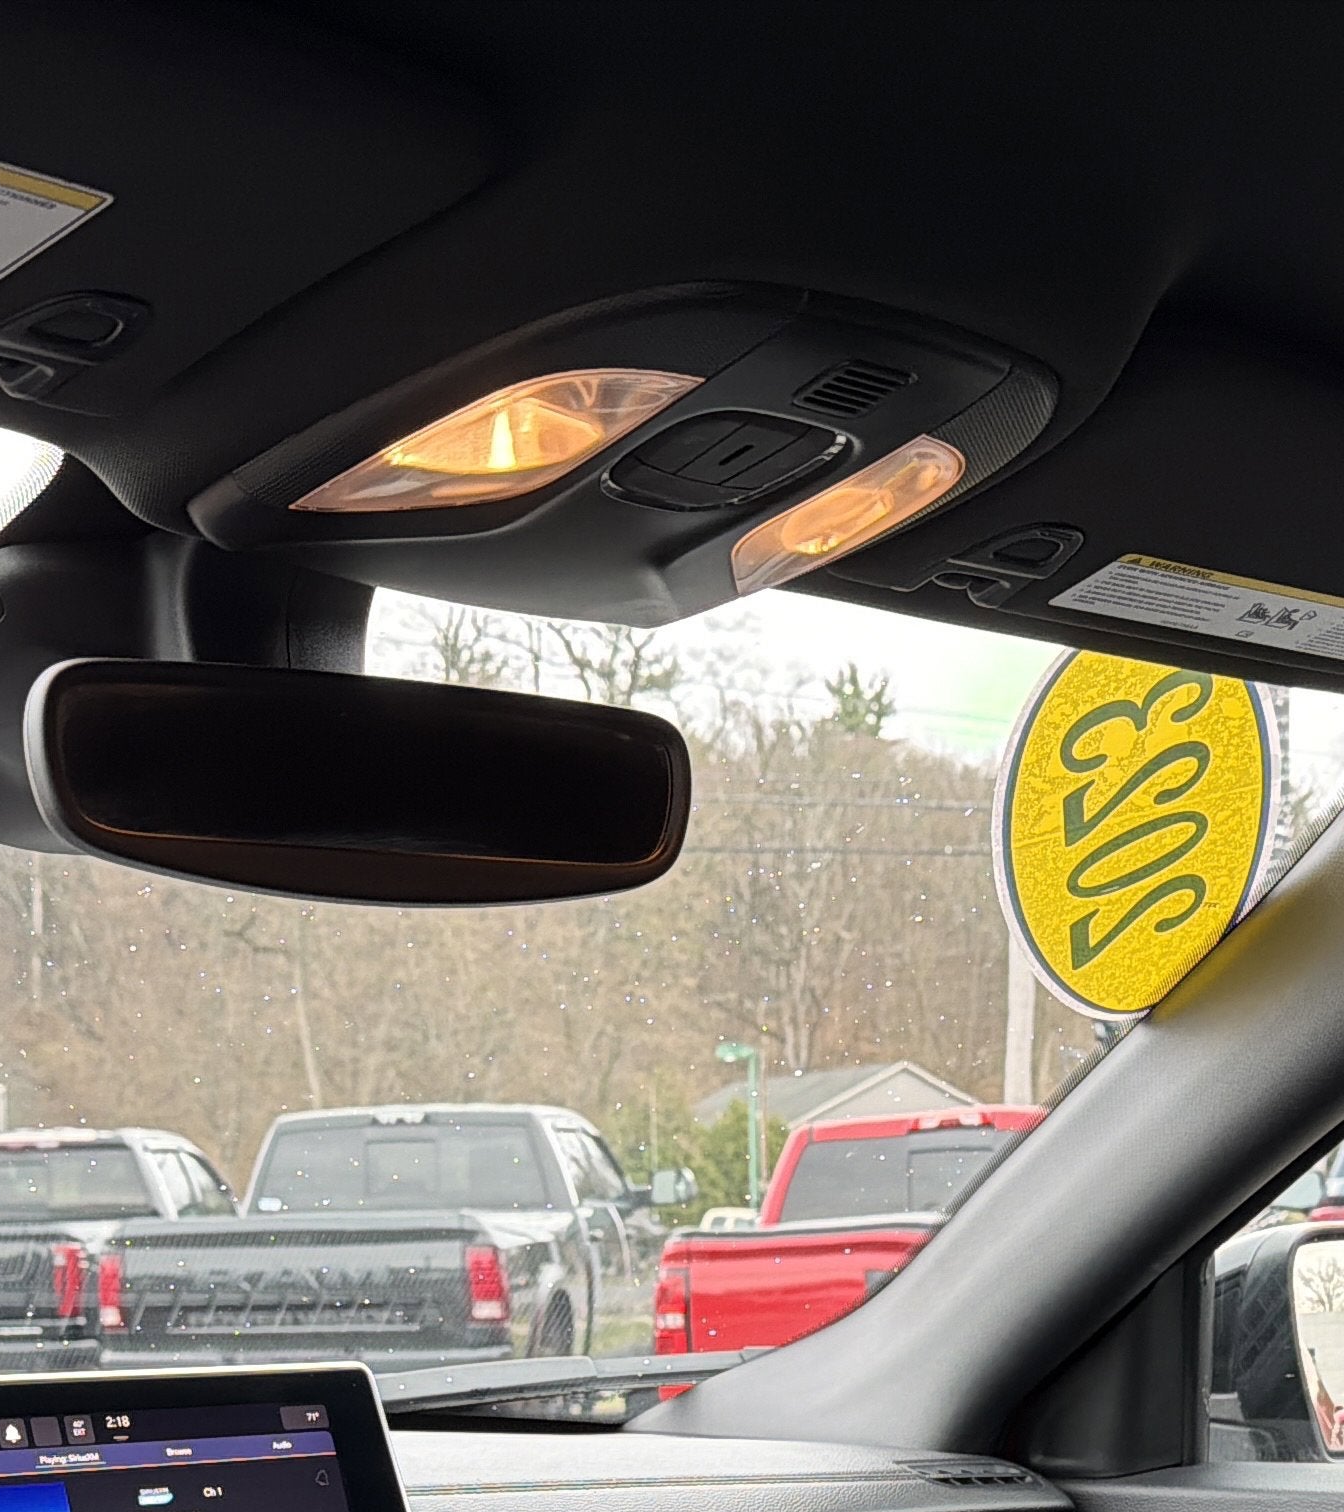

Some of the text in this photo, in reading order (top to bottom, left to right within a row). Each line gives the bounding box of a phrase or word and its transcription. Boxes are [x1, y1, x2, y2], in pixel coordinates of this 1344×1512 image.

[1149, 560, 1213, 579] WARNING
[105, 1415, 131, 1428] 2:18
[305, 1411, 320, 1422] 71°
[272, 1440, 293, 1450] Audio
[203, 1486, 216, 1498] Ch
